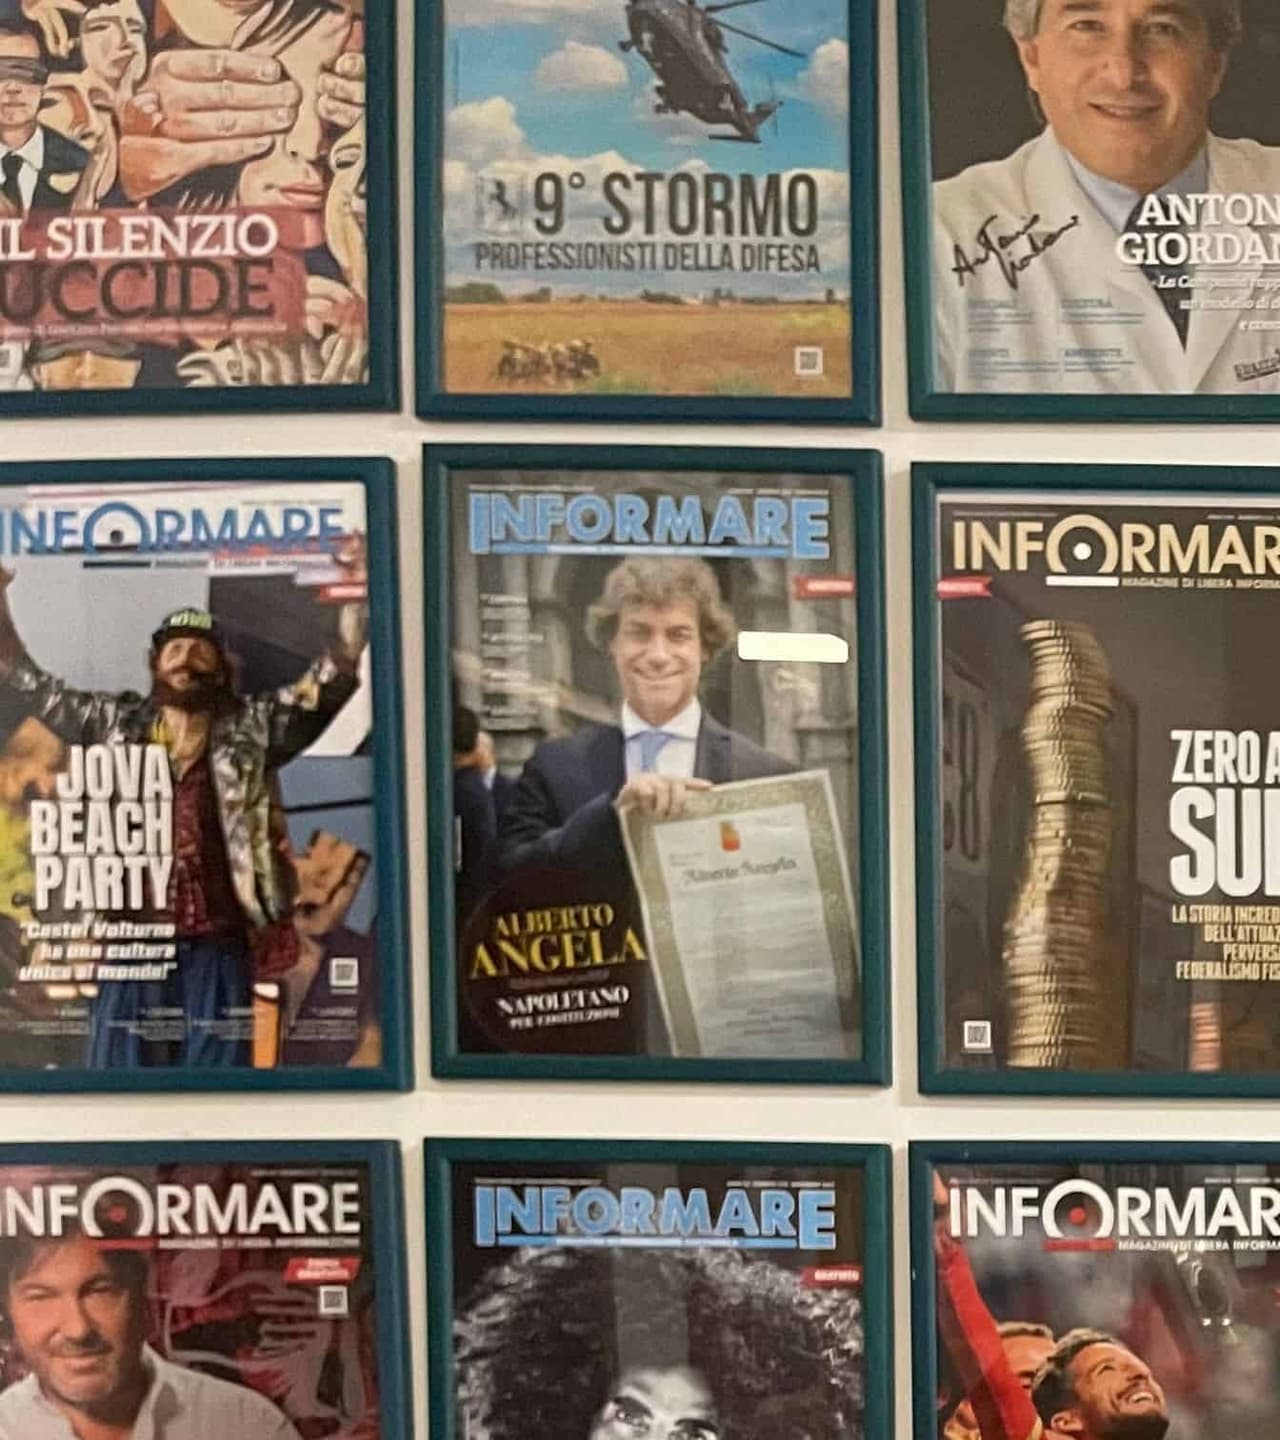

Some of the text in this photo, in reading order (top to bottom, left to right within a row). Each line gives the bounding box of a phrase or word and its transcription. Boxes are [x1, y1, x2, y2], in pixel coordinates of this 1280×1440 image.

[534, 171, 818, 237] 9° STORMO
[0, 213, 279, 260] IL SILENZIO
[475, 241, 821, 274] PROFESSIONISTI DELLA DIFESA
[0, 258, 275, 325] UCCIDE
[468, 491, 829, 559] INFORMARE
[56, 744, 171, 800] JOVA
[1170, 729, 1259, 786] ZERO
[31, 801, 173, 854] BEACH
[36, 857, 174, 911] PARTY
[496, 901, 615, 936] ALBERTO
[468, 926, 648, 979] ANGELA
[496, 985, 630, 1016] NAPOLETANO
[0, 1177, 360, 1238] NFORMARE
[474, 1186, 836, 1250] INFORMARE
